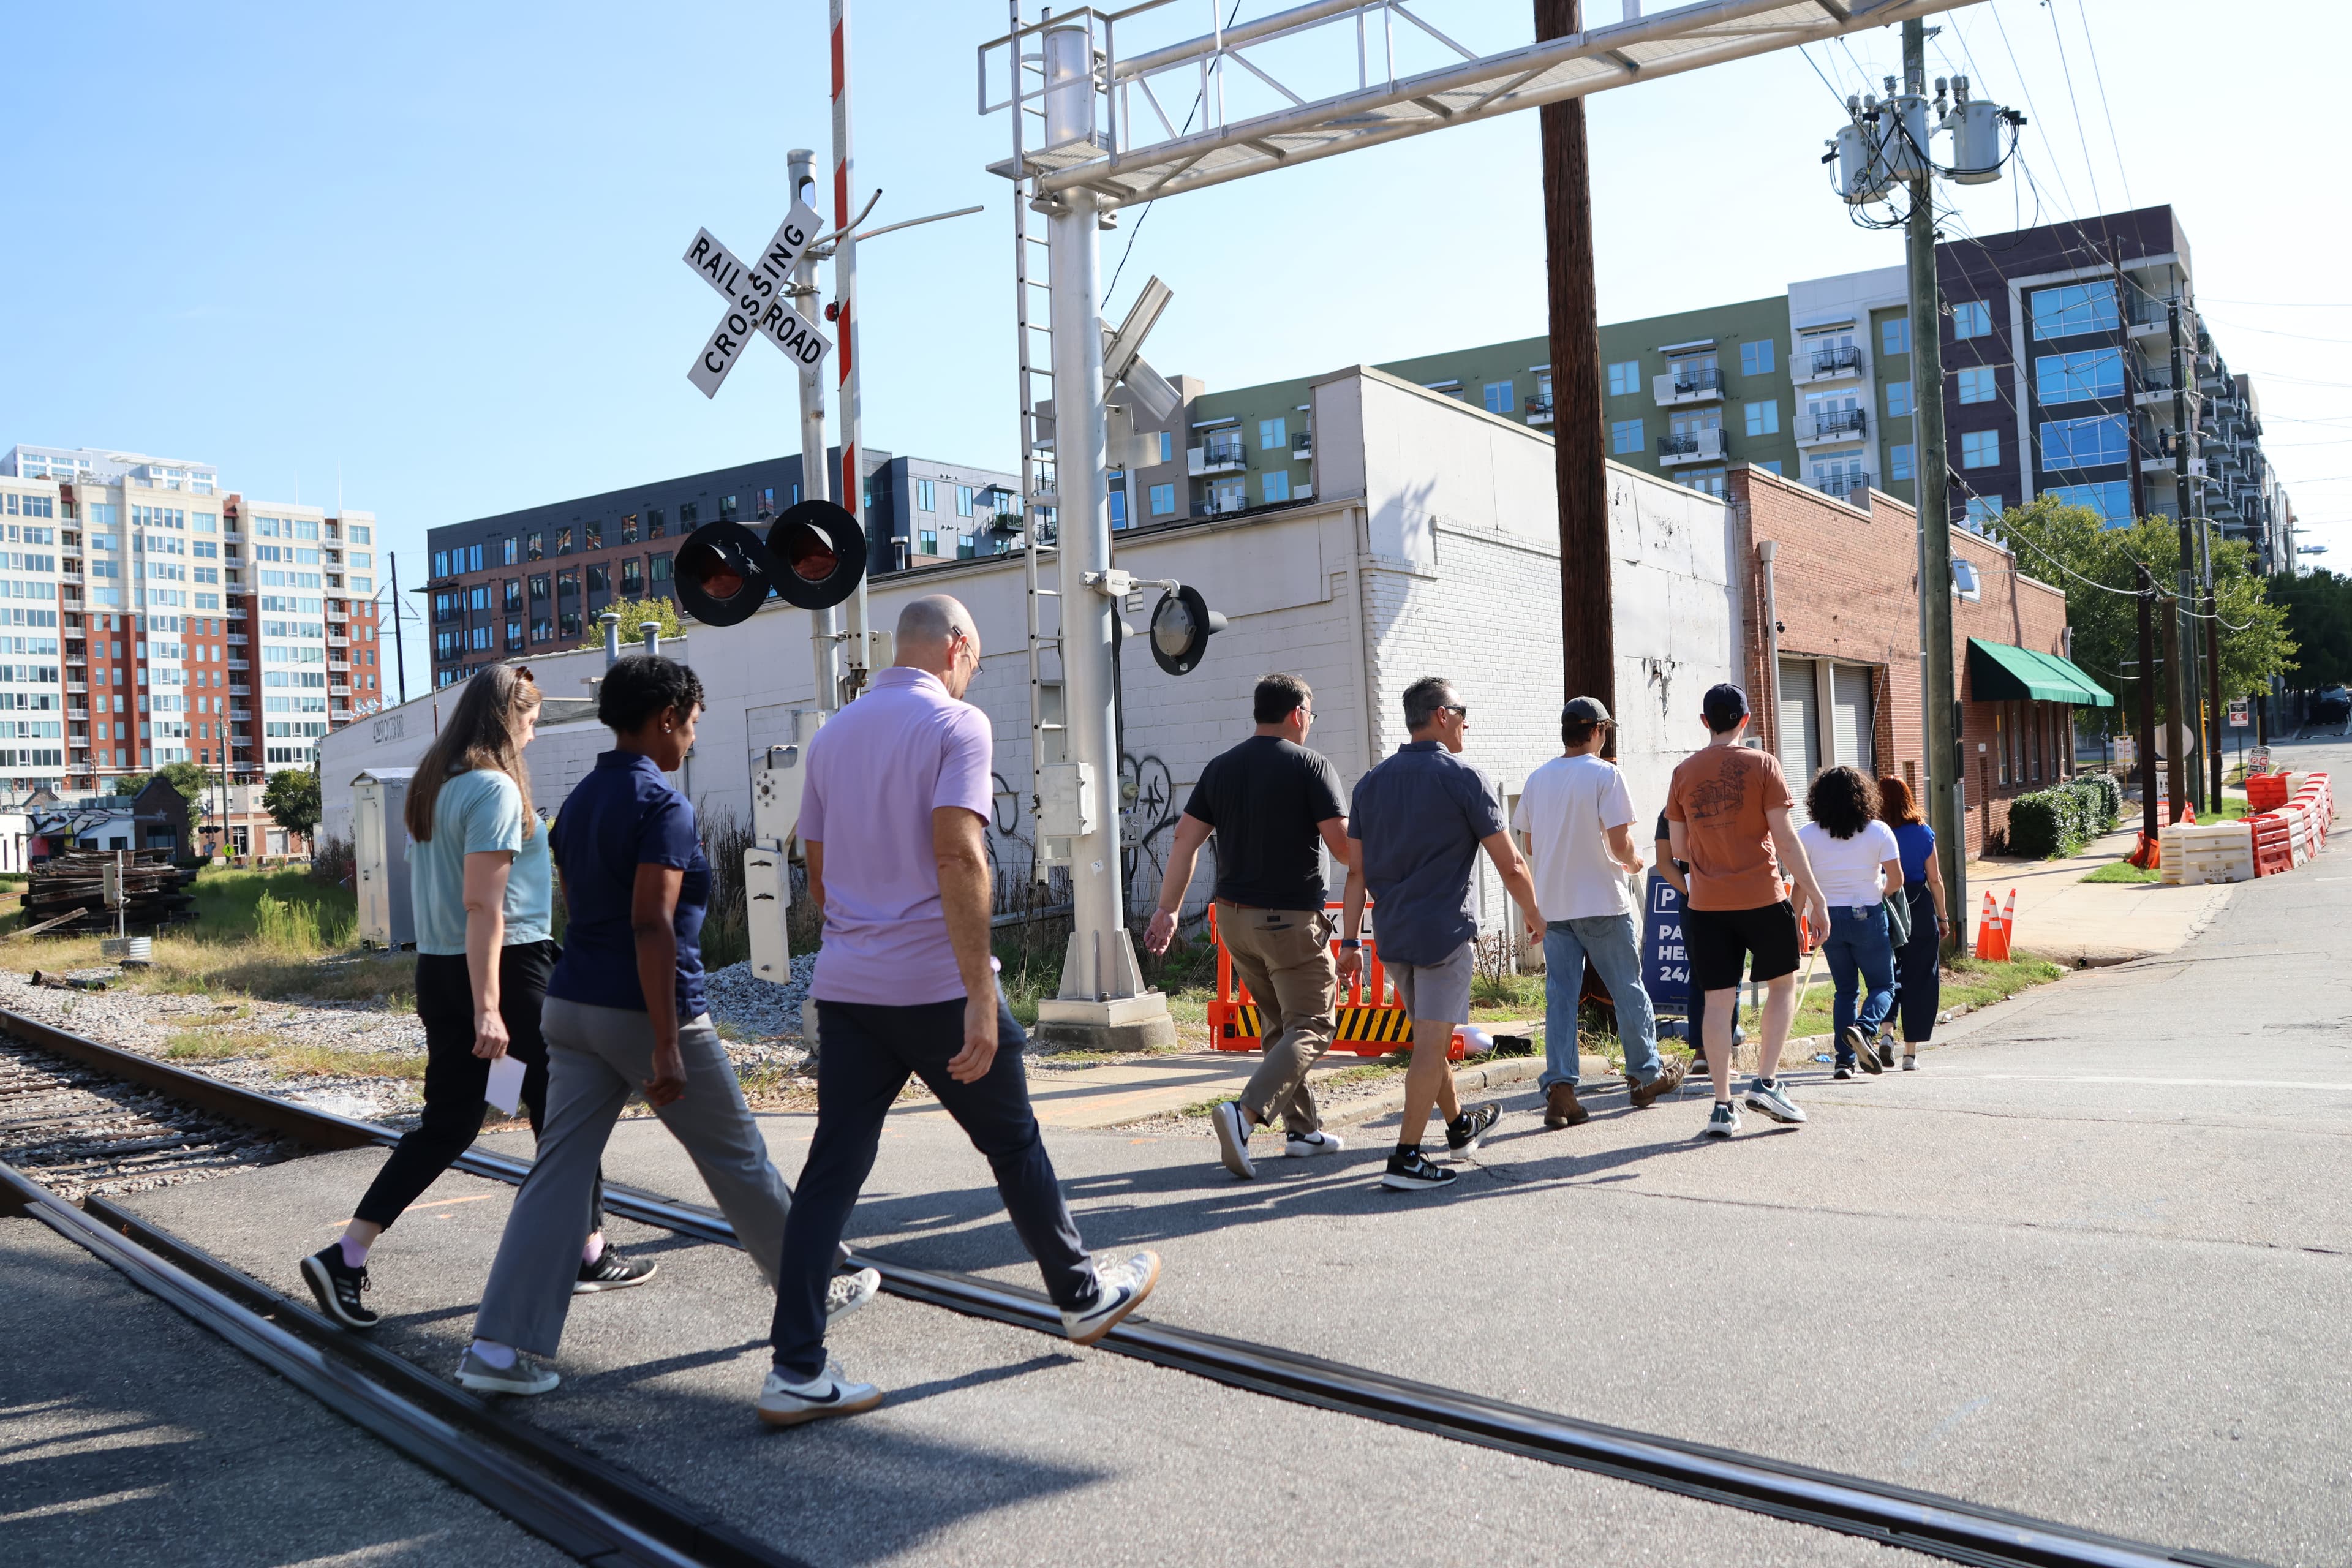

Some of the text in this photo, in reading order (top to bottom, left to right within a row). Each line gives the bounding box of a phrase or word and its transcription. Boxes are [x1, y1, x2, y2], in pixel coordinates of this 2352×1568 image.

[690, 236, 821, 364] RAIL ROAD
[704, 224, 804, 374] CROSSING
[1660, 888, 1676, 907] P
[1659, 925, 1683, 940] PA
[1658, 946, 1689, 961] HE
[1660, 966, 1691, 984] 24/
